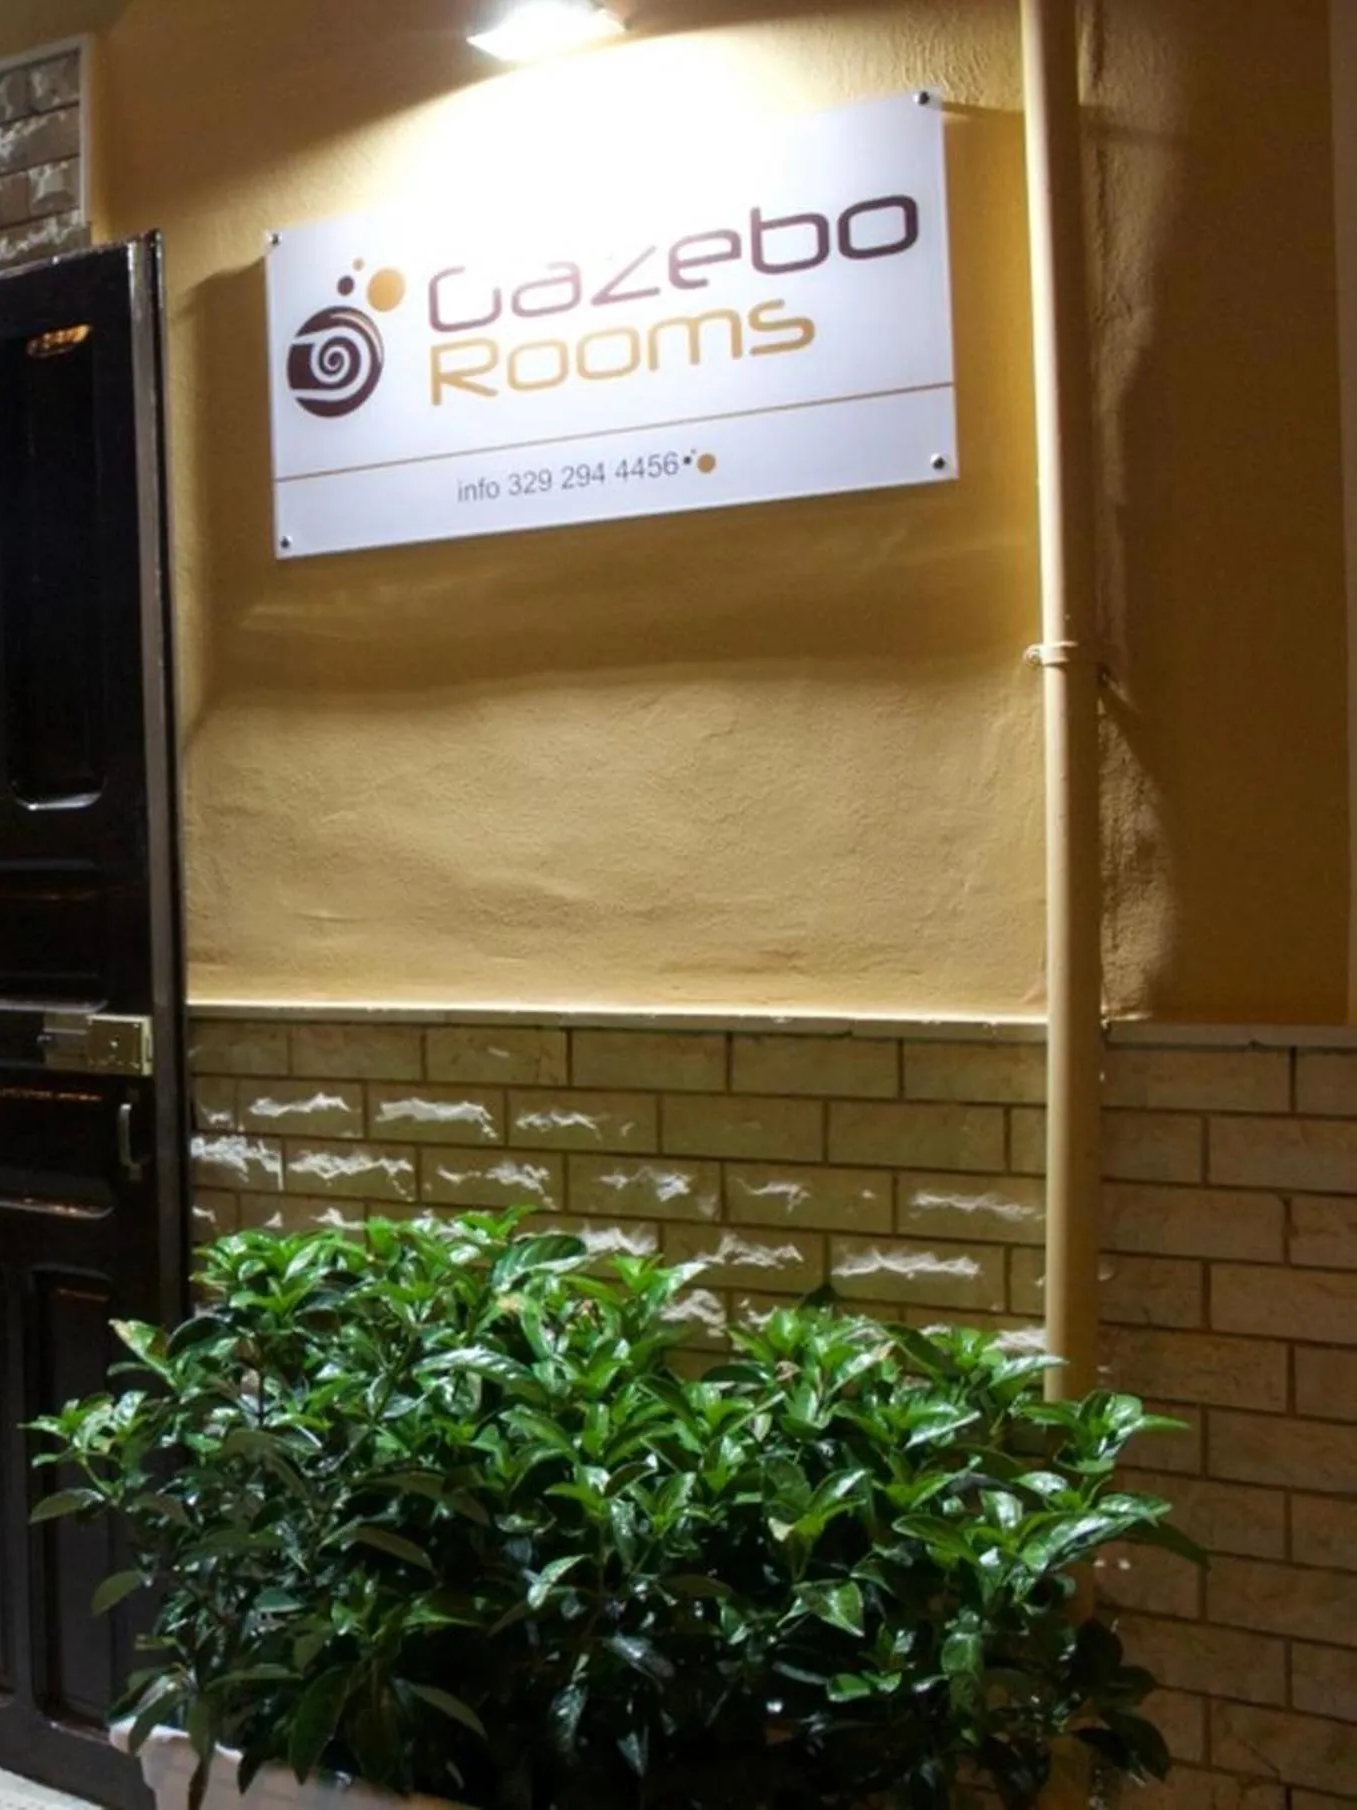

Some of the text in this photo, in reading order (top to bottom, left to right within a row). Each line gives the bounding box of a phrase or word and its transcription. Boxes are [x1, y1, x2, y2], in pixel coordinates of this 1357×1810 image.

[428, 194, 919, 333] Gazebo
[456, 450, 680, 502] info 329 294 4456
